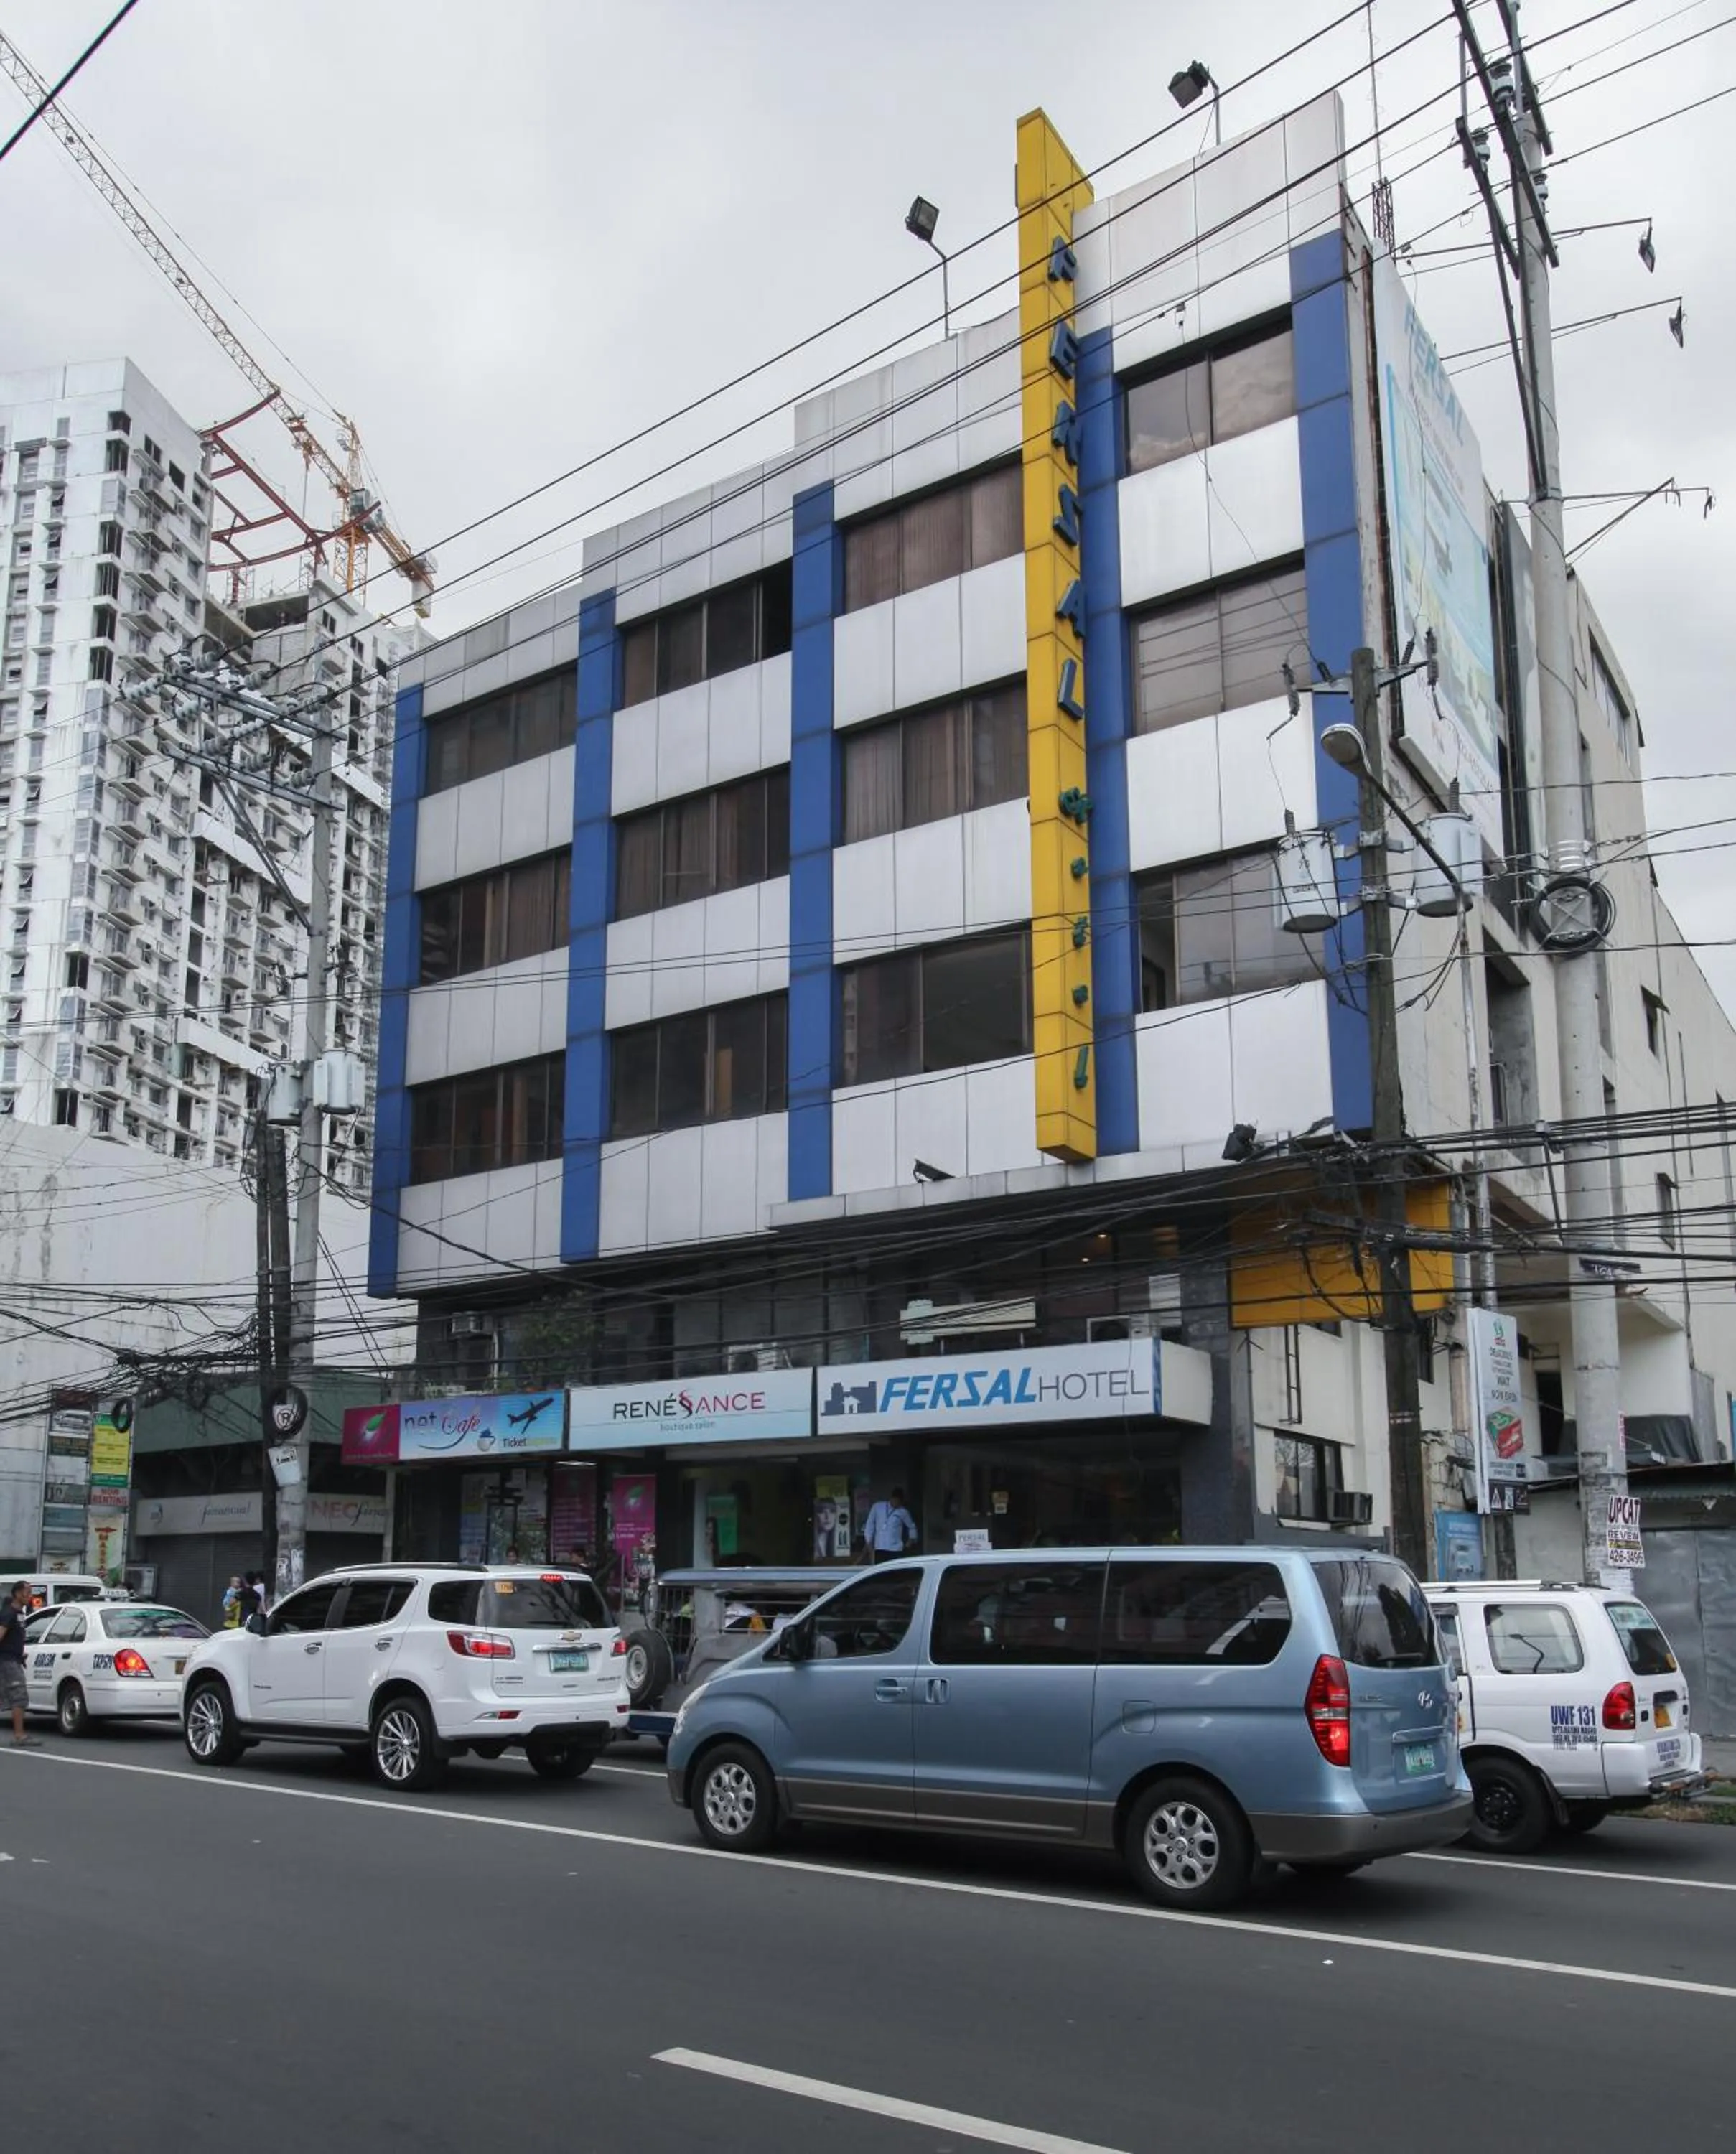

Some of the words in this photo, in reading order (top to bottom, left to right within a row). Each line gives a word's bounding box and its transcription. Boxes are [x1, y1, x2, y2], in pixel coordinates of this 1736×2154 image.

[1047, 233, 1085, 722] FERSAL
[879, 1366, 1040, 1413] FERSAL
[1039, 1369, 1149, 1402] HOTEL
[1609, 1497, 1640, 1525] UPCAT
[1551, 1705, 1574, 1725] UWF
[1577, 1705, 1596, 1726] 131
